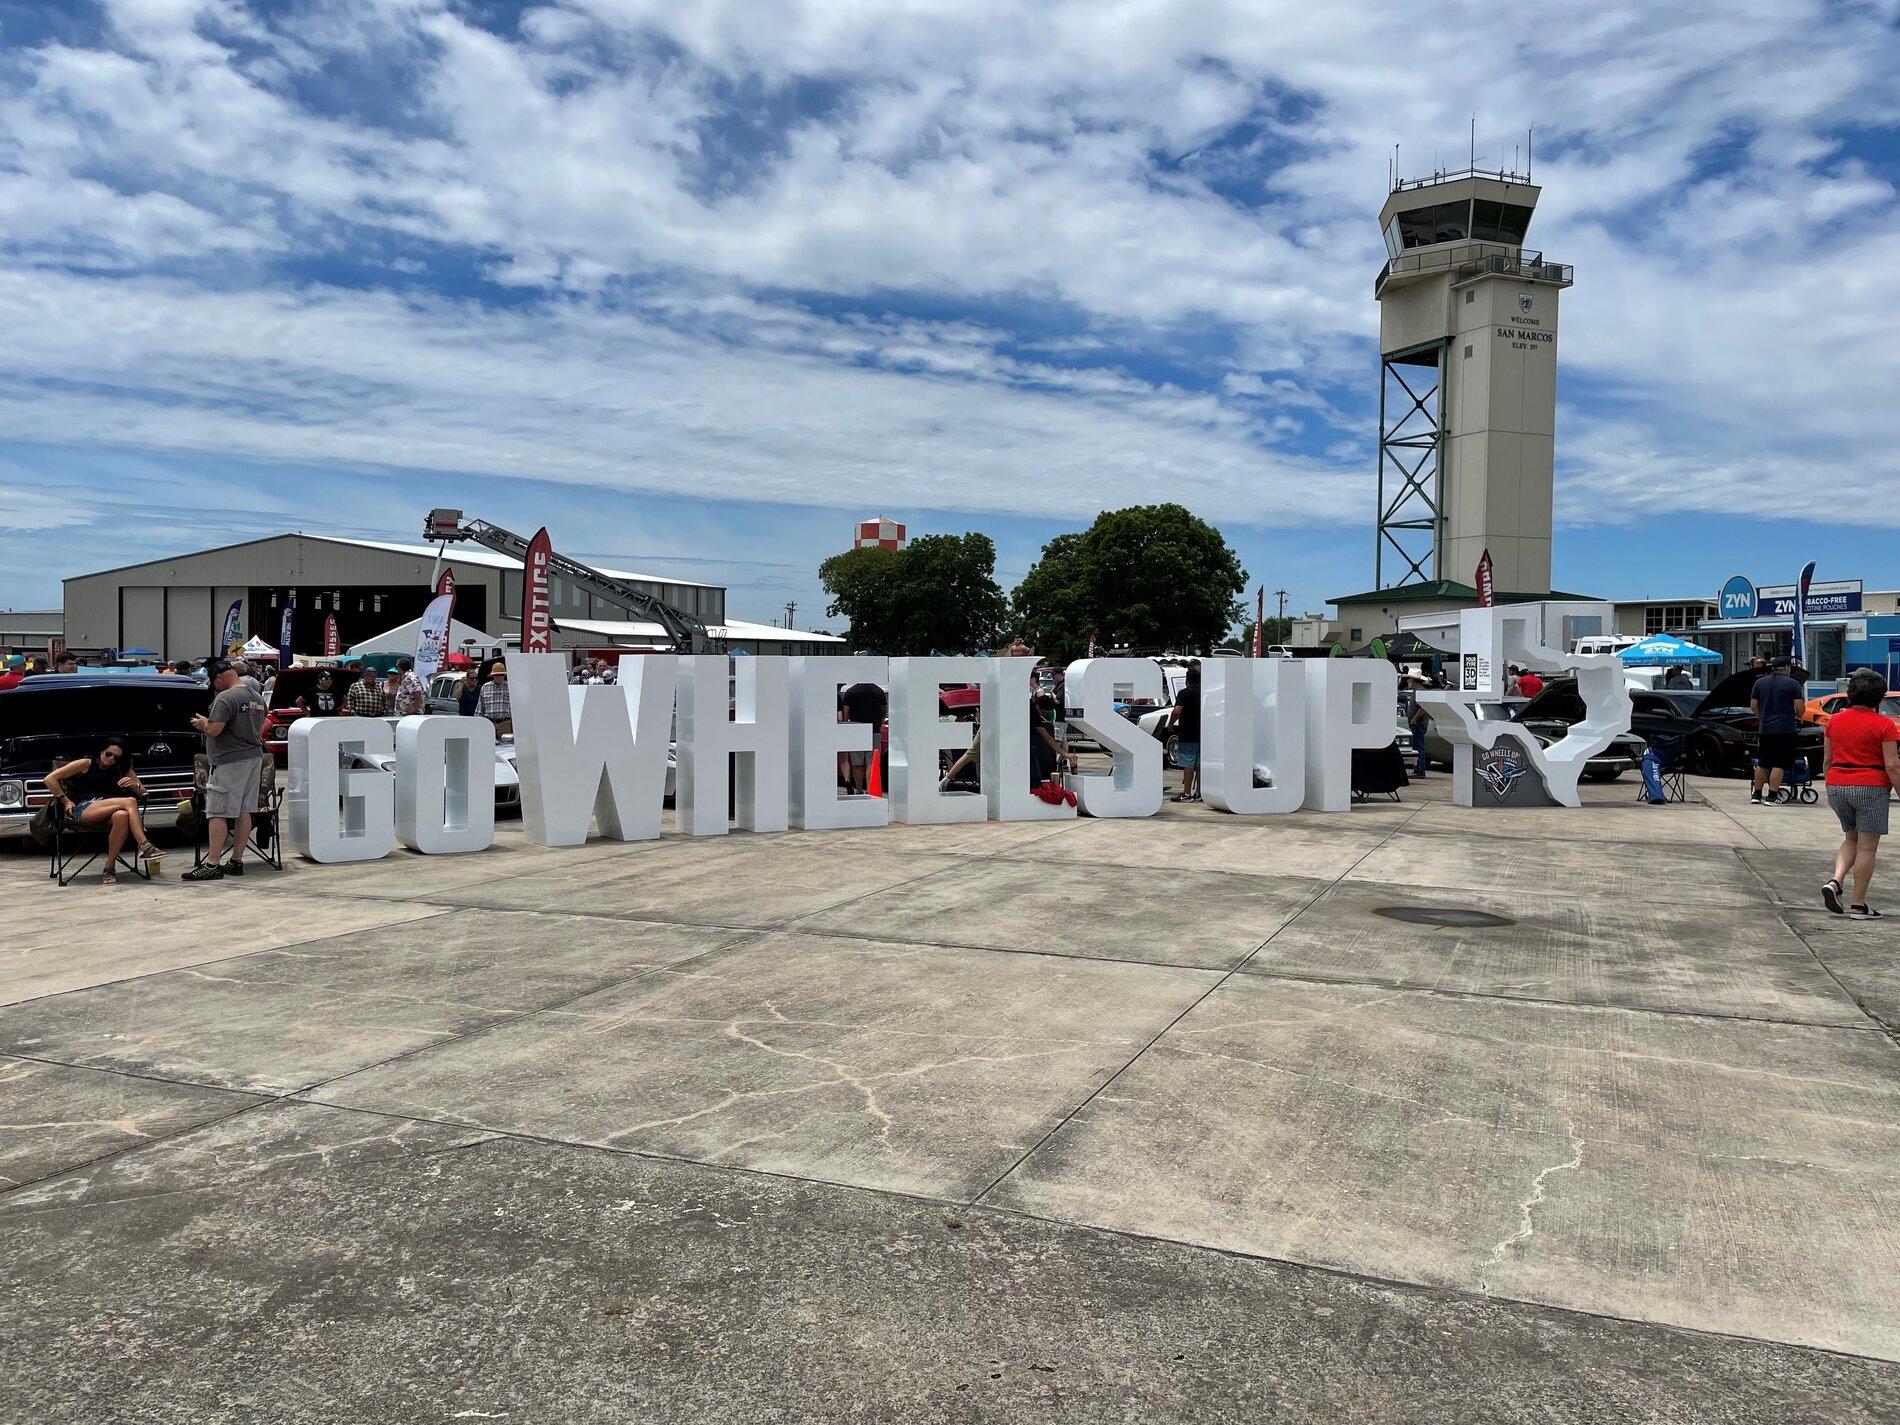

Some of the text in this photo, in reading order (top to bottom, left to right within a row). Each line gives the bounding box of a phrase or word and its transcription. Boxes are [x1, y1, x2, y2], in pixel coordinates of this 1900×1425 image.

[1511, 316, 1539, 325] WELCOME
[1497, 328, 1553, 342] SAN MARCOS
[1725, 592, 1750, 609] ZYN
[1775, 596, 1848, 613] ZYN BACCO-FREE
[1465, 669, 1477, 678] 3D
[288, 652, 1399, 864] GO WHEELS UP
[1481, 751, 1490, 761] GO
[1489, 749, 1511, 757] WHEELS
